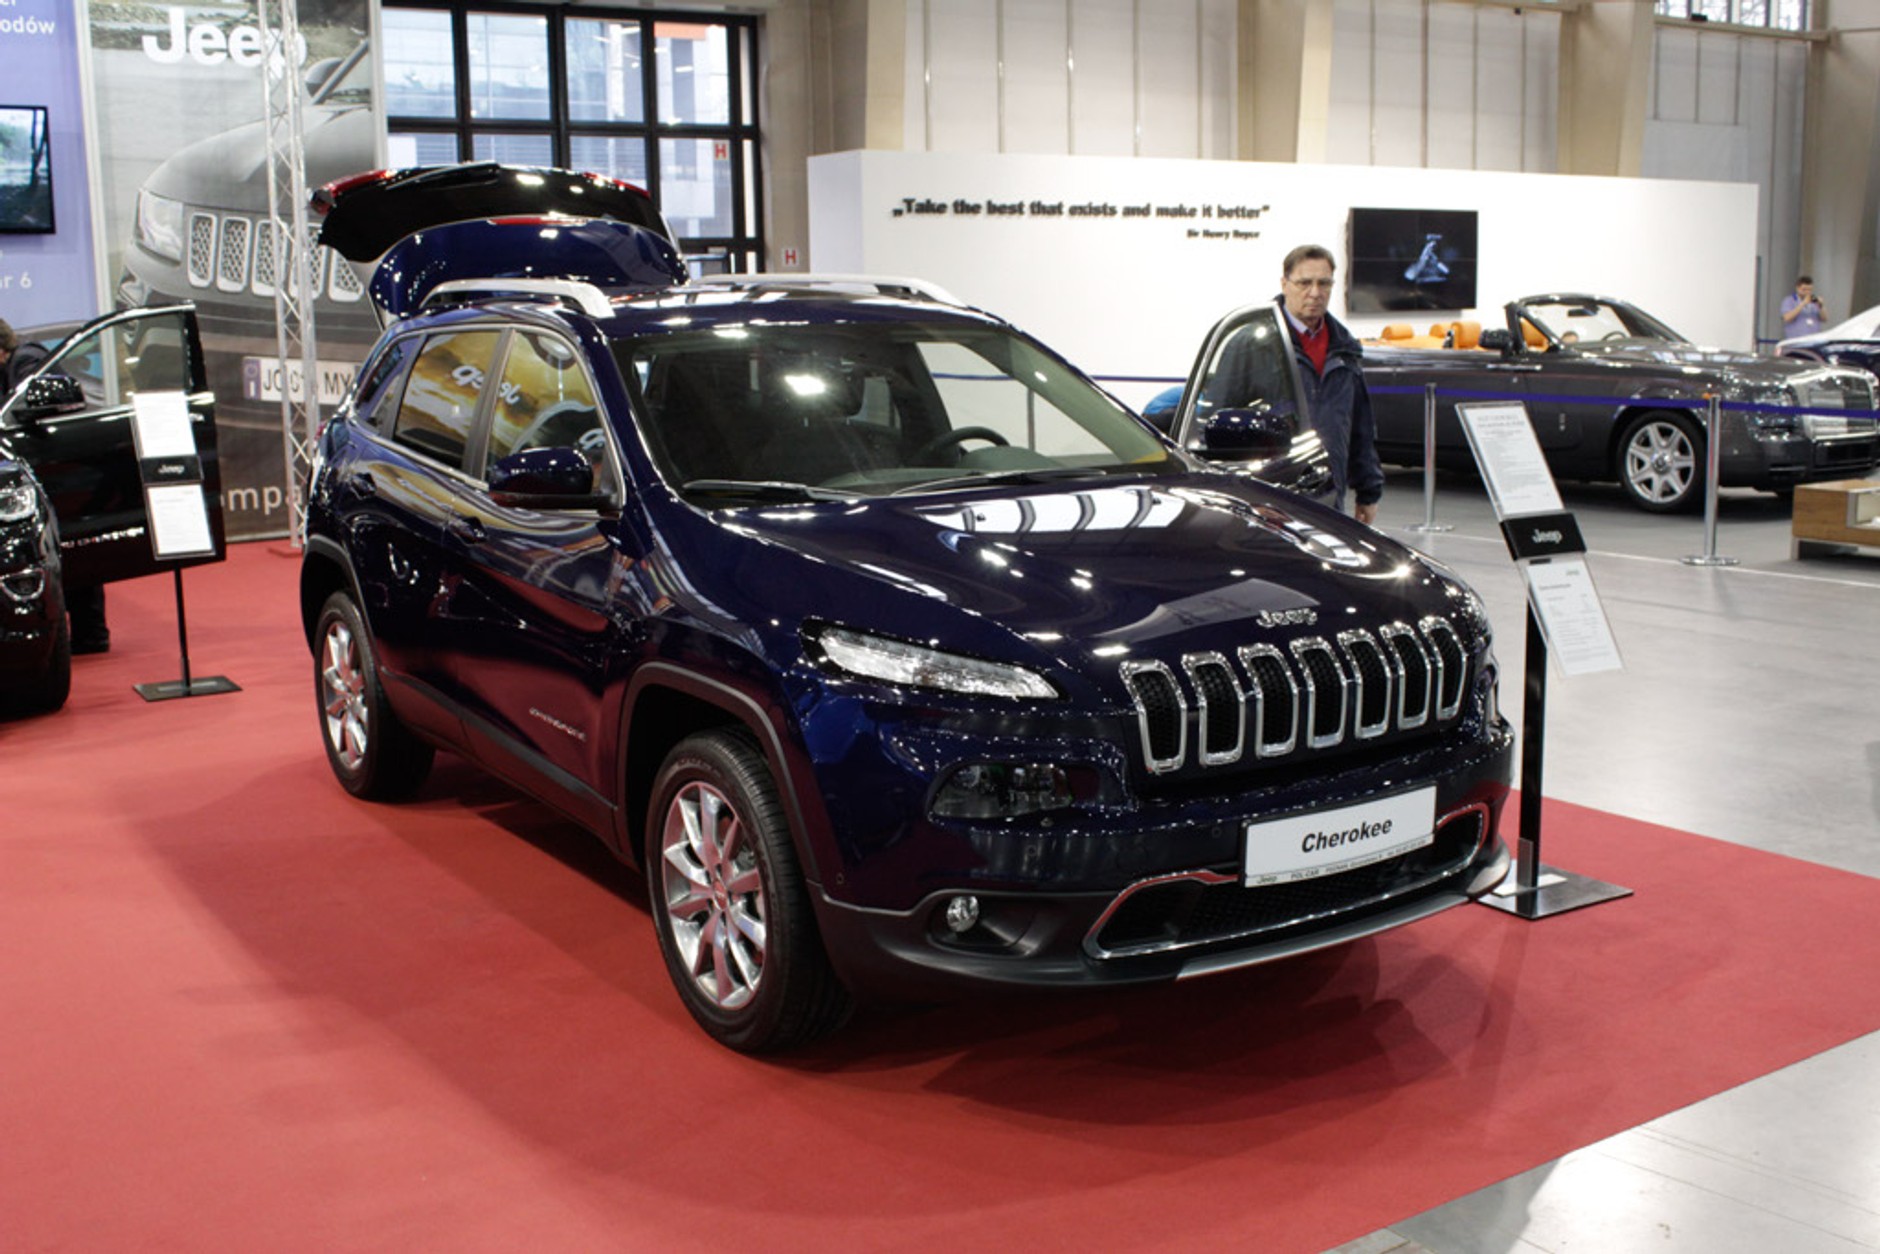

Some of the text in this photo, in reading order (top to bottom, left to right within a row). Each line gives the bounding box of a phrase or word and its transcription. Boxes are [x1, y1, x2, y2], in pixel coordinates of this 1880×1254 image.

[0, 15, 55, 35] odów
[141, 7, 307, 79] Jeep
[714, 143, 727, 159] H
[953, 199, 982, 215] the
[987, 199, 1025, 216] best
[1030, 201, 1063, 216] that
[1068, 202, 1118, 217] exists
[1122, 203, 1151, 218] and
[1156, 204, 1197, 218] make
[1202, 204, 1212, 219] it
[784, 249, 797, 265] H
[20, 270, 32, 289] 6
[1532, 528, 1563, 545] Jeep
[1256, 608, 1318, 628] Jeep
[1301, 818, 1393, 854] Cherokee
